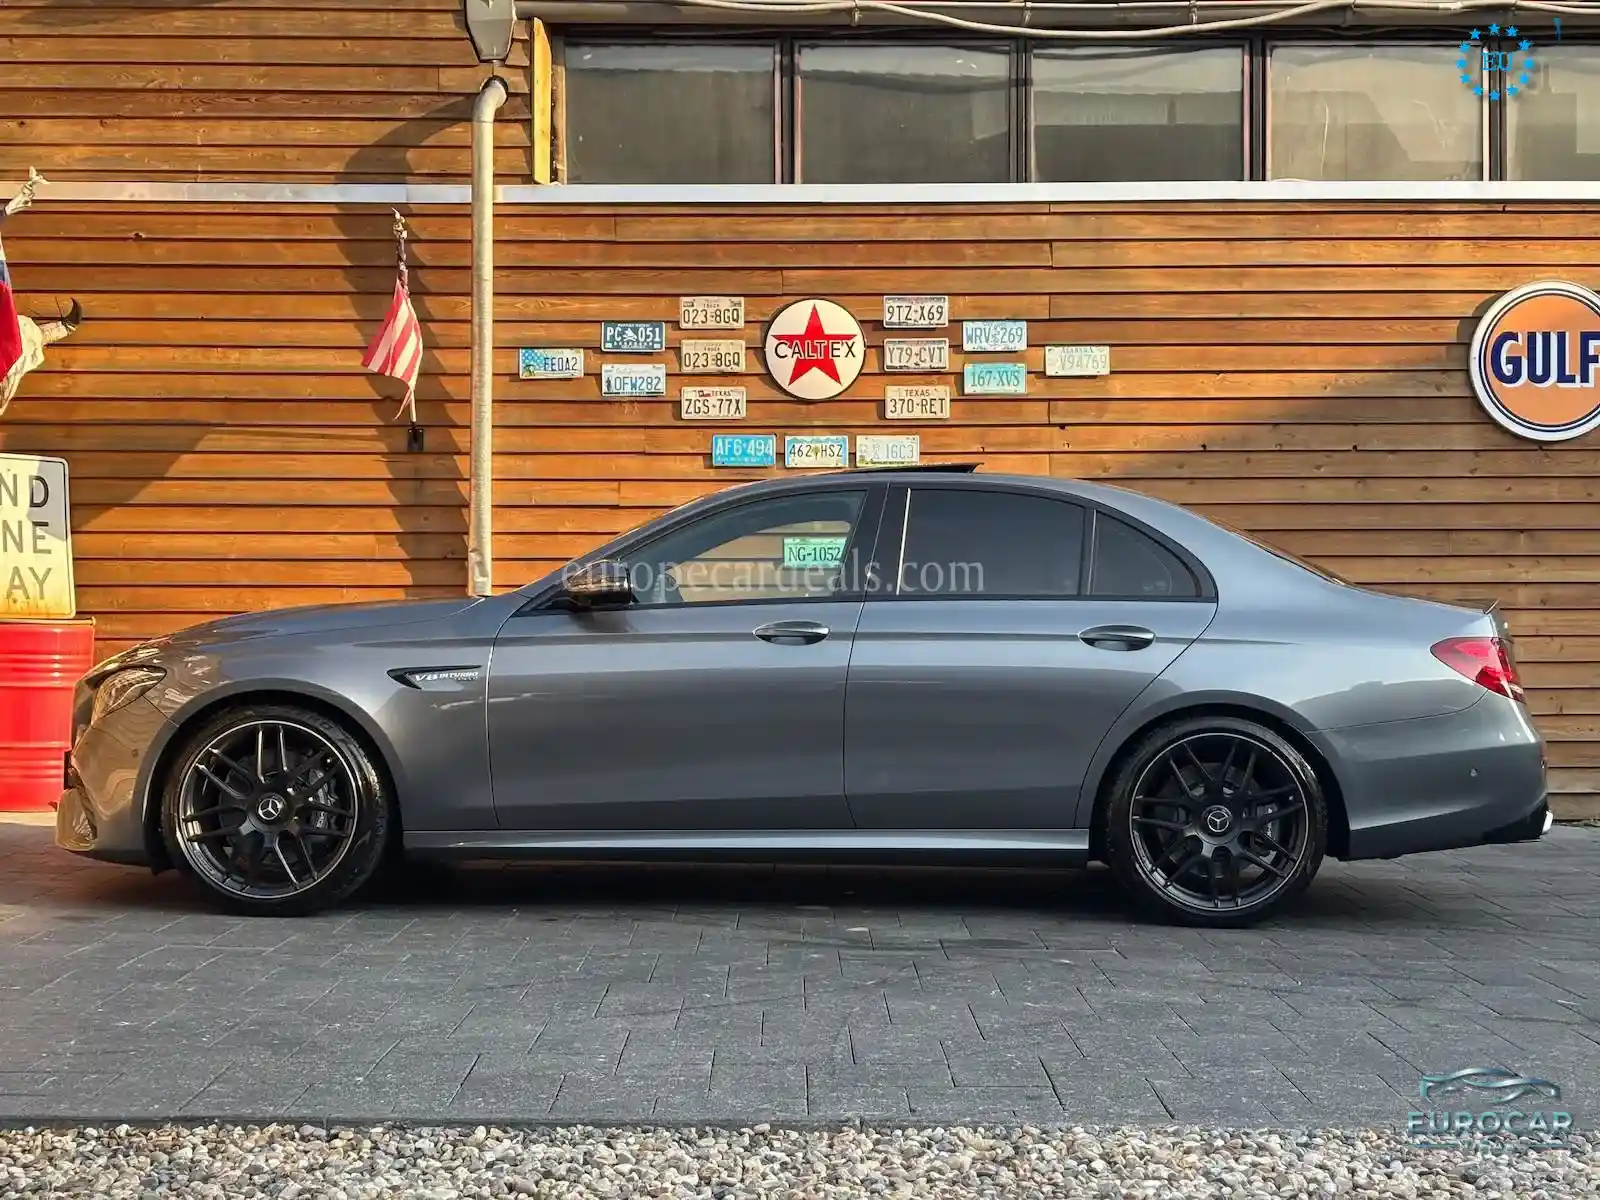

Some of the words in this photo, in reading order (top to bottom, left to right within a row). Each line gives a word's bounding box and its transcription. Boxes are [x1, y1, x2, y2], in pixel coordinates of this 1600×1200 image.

[774, 340, 856, 360] CALTEX
[1490, 330, 1600, 388] GULF
[904, 389, 931, 397] TEXAS
[2, 520, 52, 554] NE
[6, 566, 52, 600] AY
